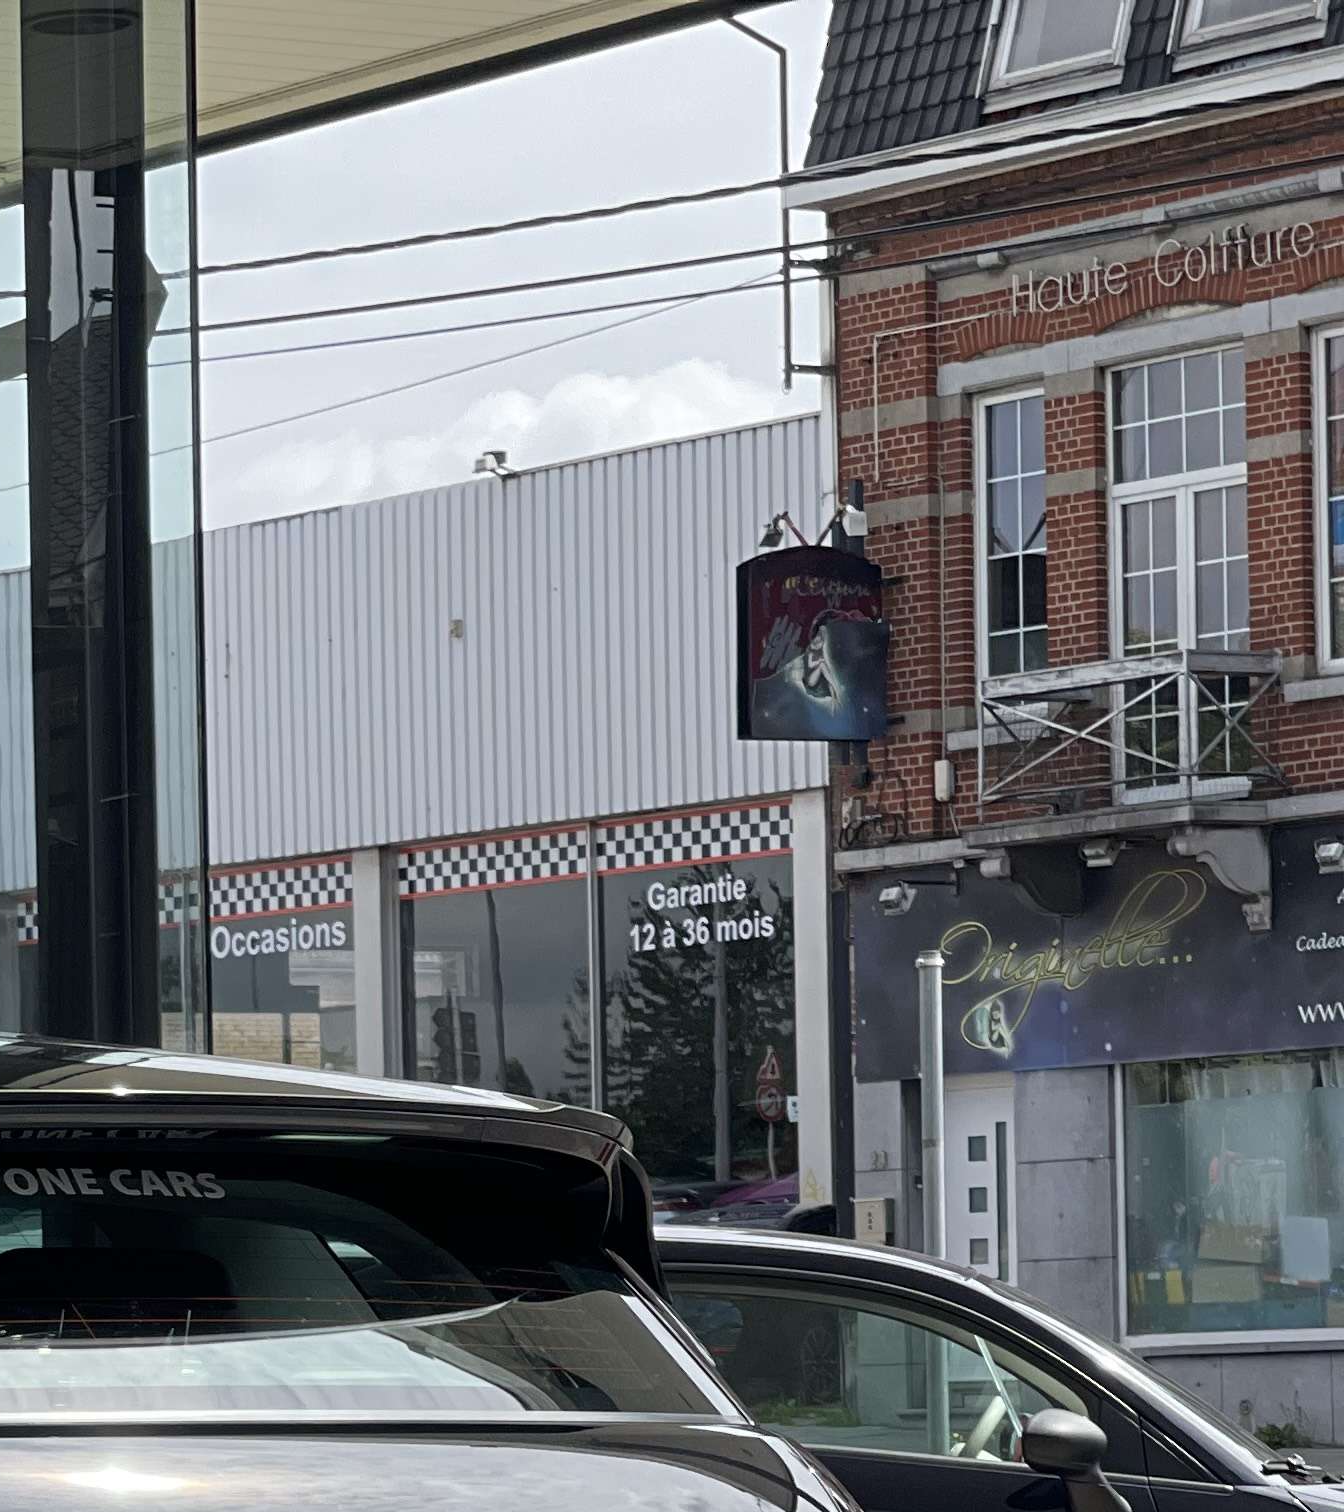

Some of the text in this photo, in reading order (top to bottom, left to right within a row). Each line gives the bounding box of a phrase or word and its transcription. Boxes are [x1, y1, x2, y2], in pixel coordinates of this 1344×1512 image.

[1012, 222, 1315, 317] Haute Coiffure
[647, 873, 747, 911] Garantie
[211, 917, 347, 959] Occasions
[629, 909, 775, 952] 12 à 36 mois
[3, 1167, 226, 1200] ONE CARS
